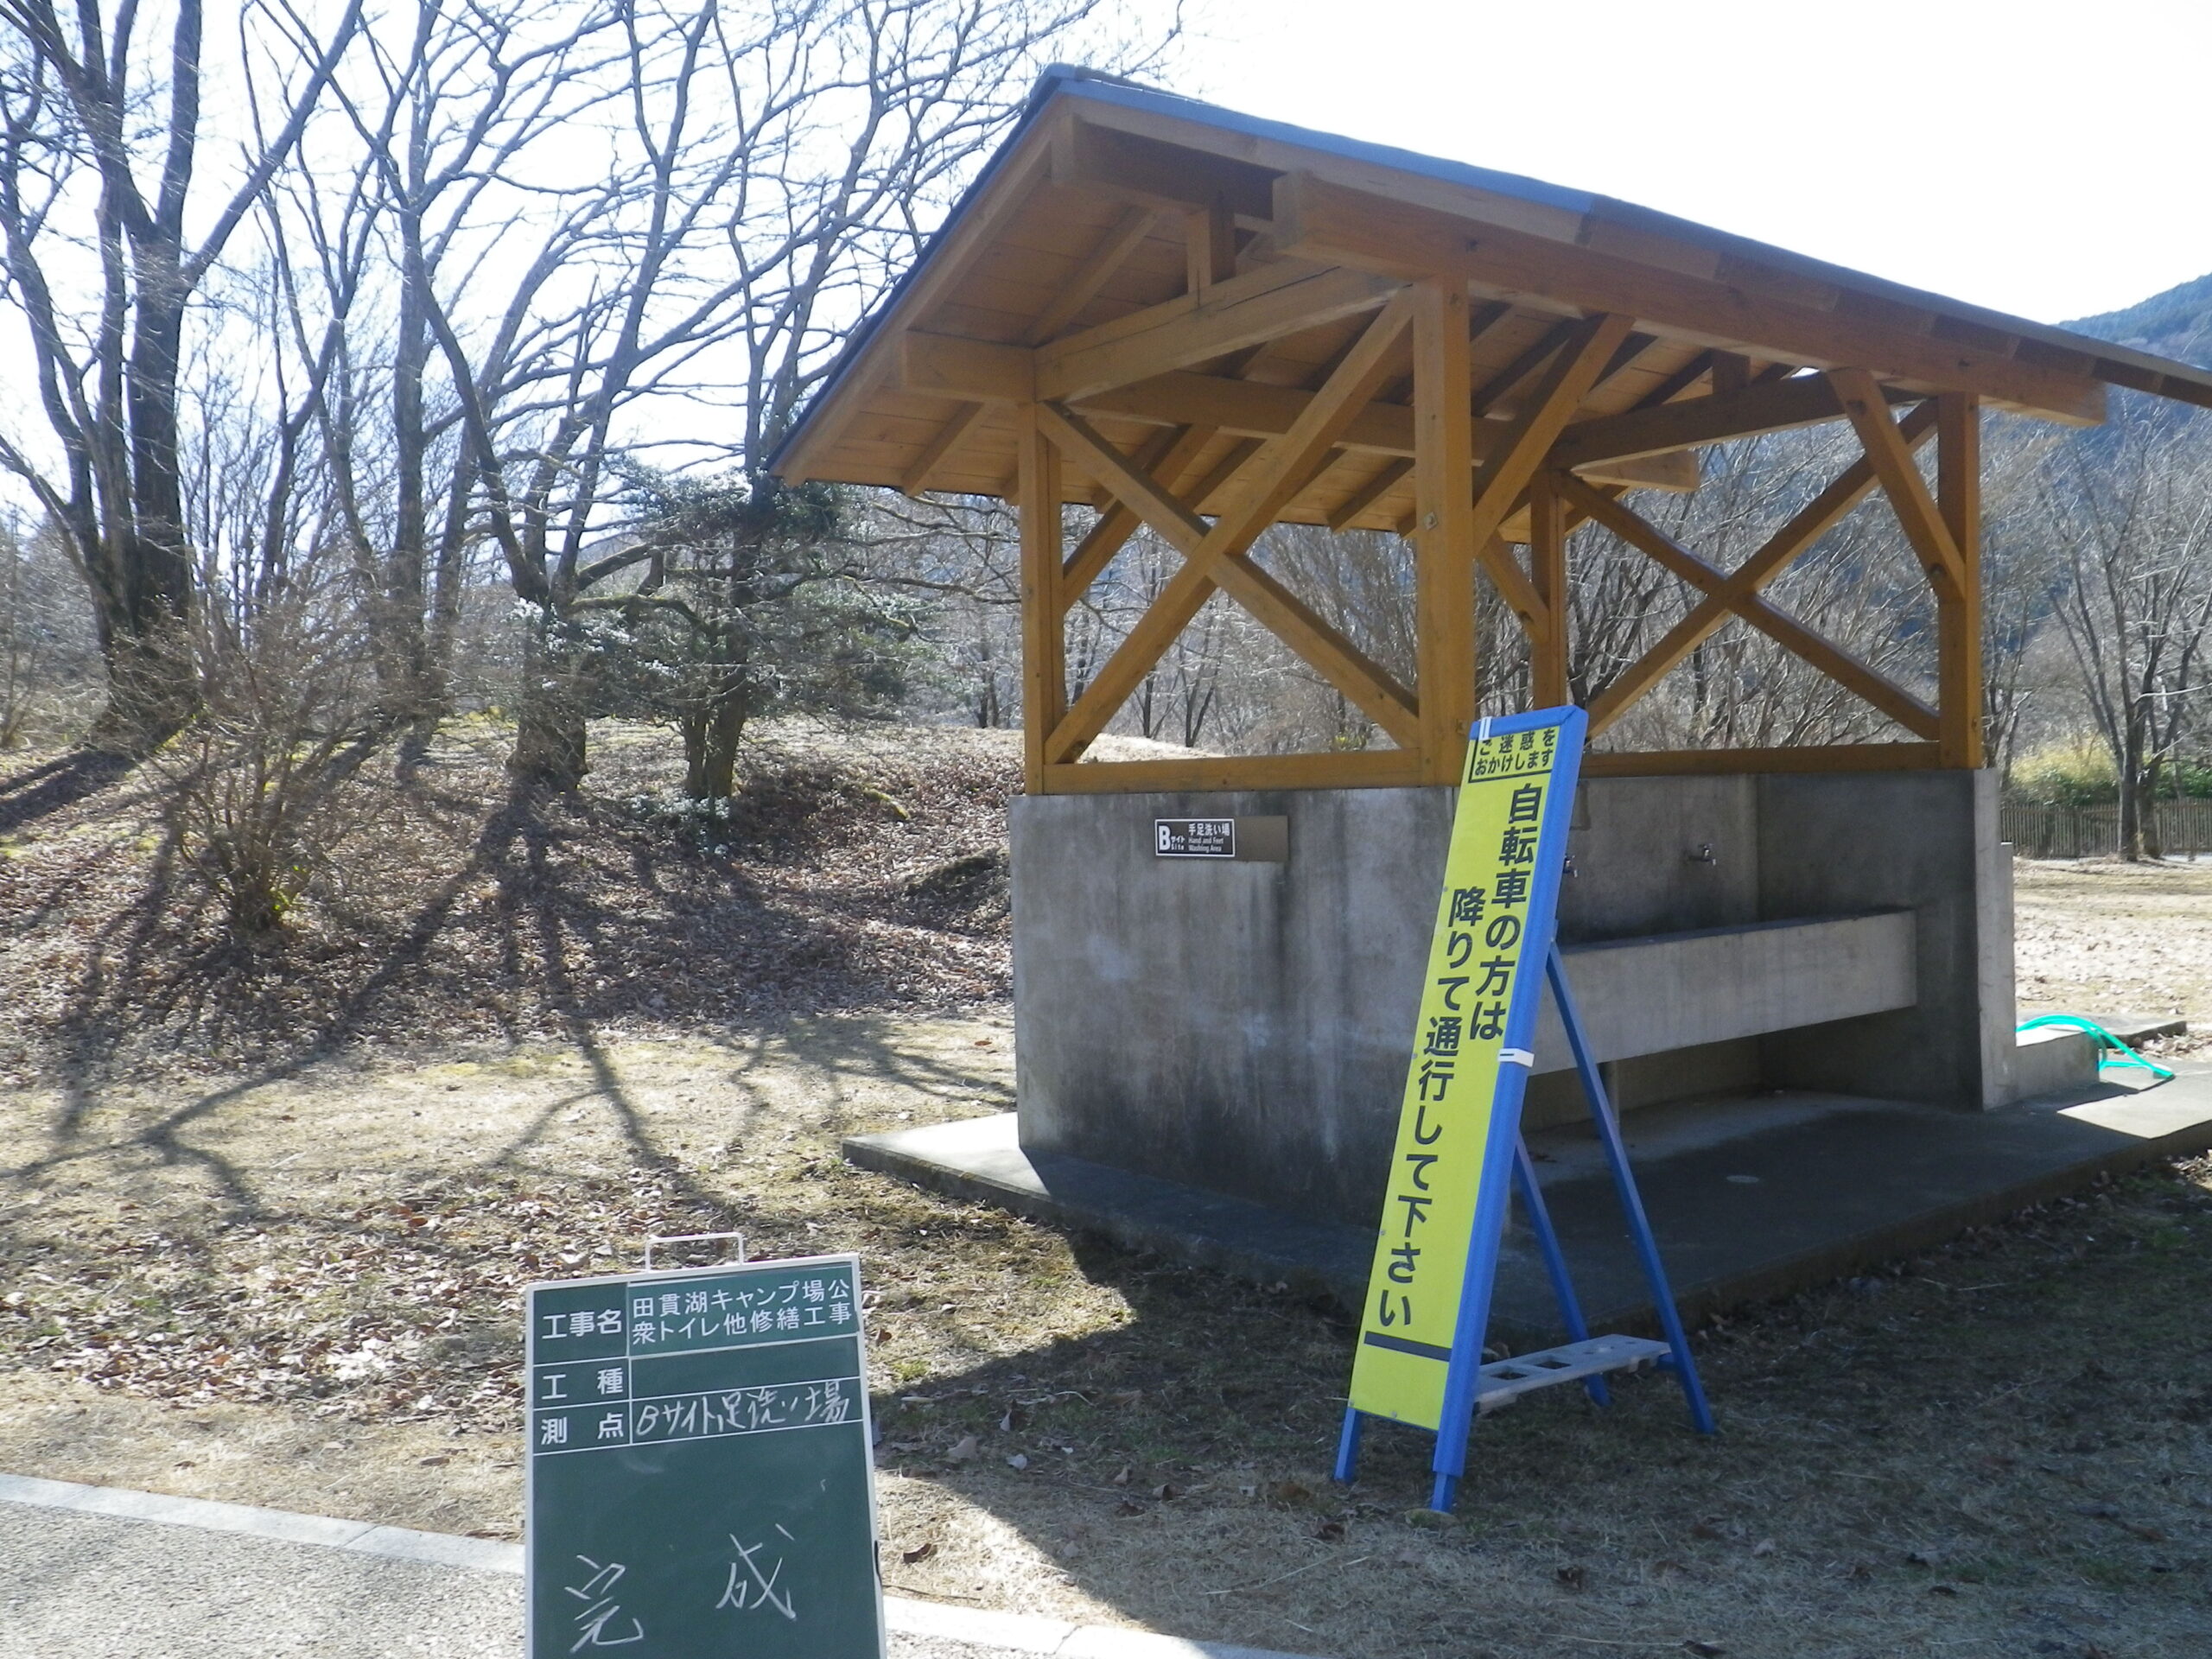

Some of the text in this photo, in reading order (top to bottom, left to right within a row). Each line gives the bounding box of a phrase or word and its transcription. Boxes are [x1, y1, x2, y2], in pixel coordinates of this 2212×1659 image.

[1480, 728, 1555, 756] ご迷惑を
[1474, 748, 1554, 776] おかけします
[1188, 823, 1230, 836] 手足洗い場
[1470, 783, 1543, 1040] 自転車の方は
[1379, 886, 1486, 1327] 降りて通行して下さい
[632, 1279, 850, 1319] 田貫湖キャンプ場公
[542, 1309, 623, 1339] 工事名
[632, 1301, 853, 1345] 衆トイレ他修繕工事
